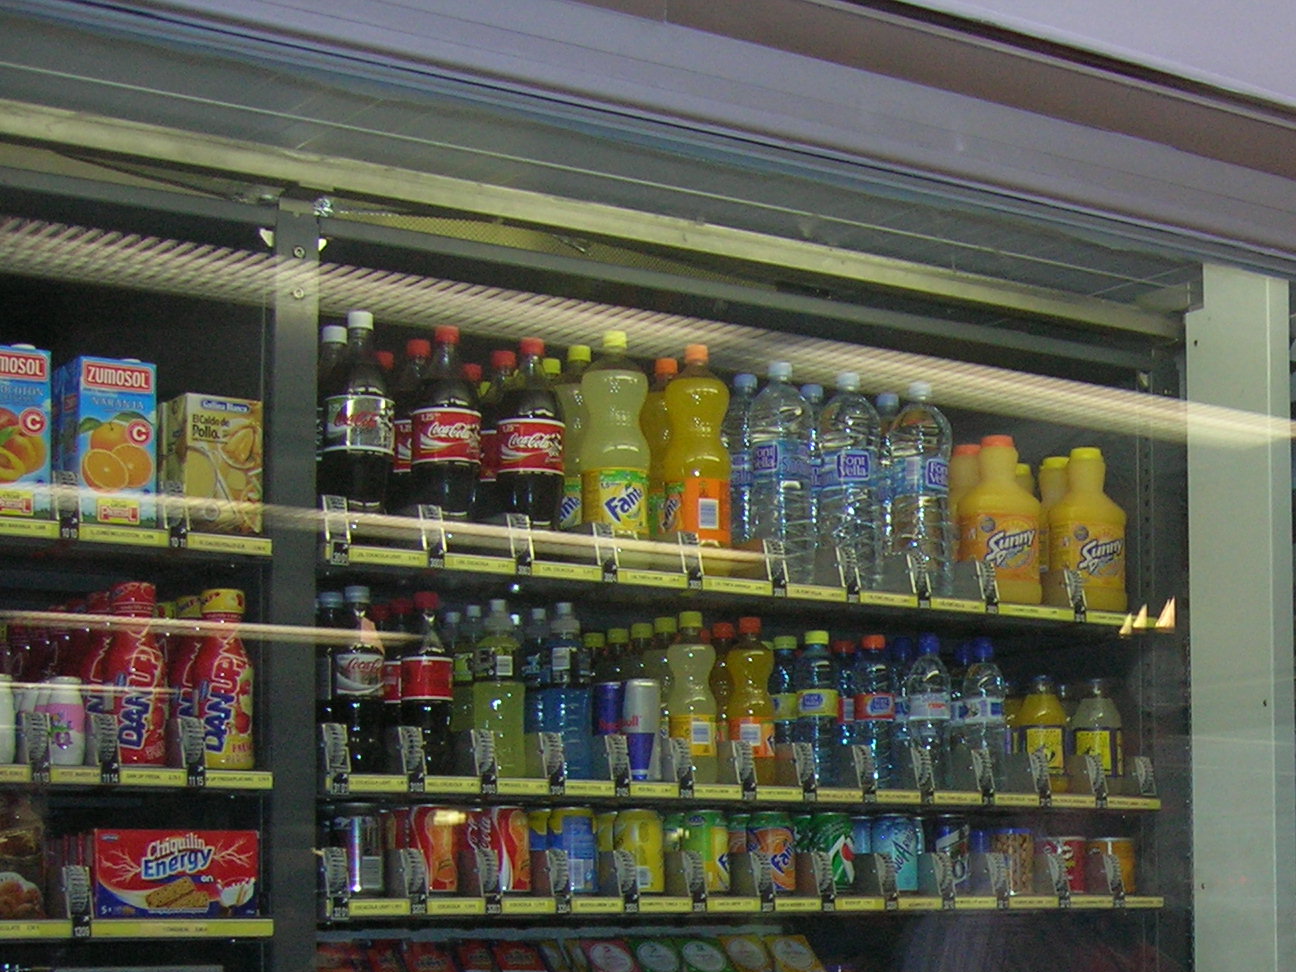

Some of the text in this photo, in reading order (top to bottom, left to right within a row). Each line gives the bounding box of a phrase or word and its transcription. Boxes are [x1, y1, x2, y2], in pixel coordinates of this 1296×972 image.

[87, 366, 149, 389] ZUMOSOL
[986, 529, 1036, 561] Sunny
[1078, 539, 1123, 570] Sunny
[142, 848, 215, 880] Energy
